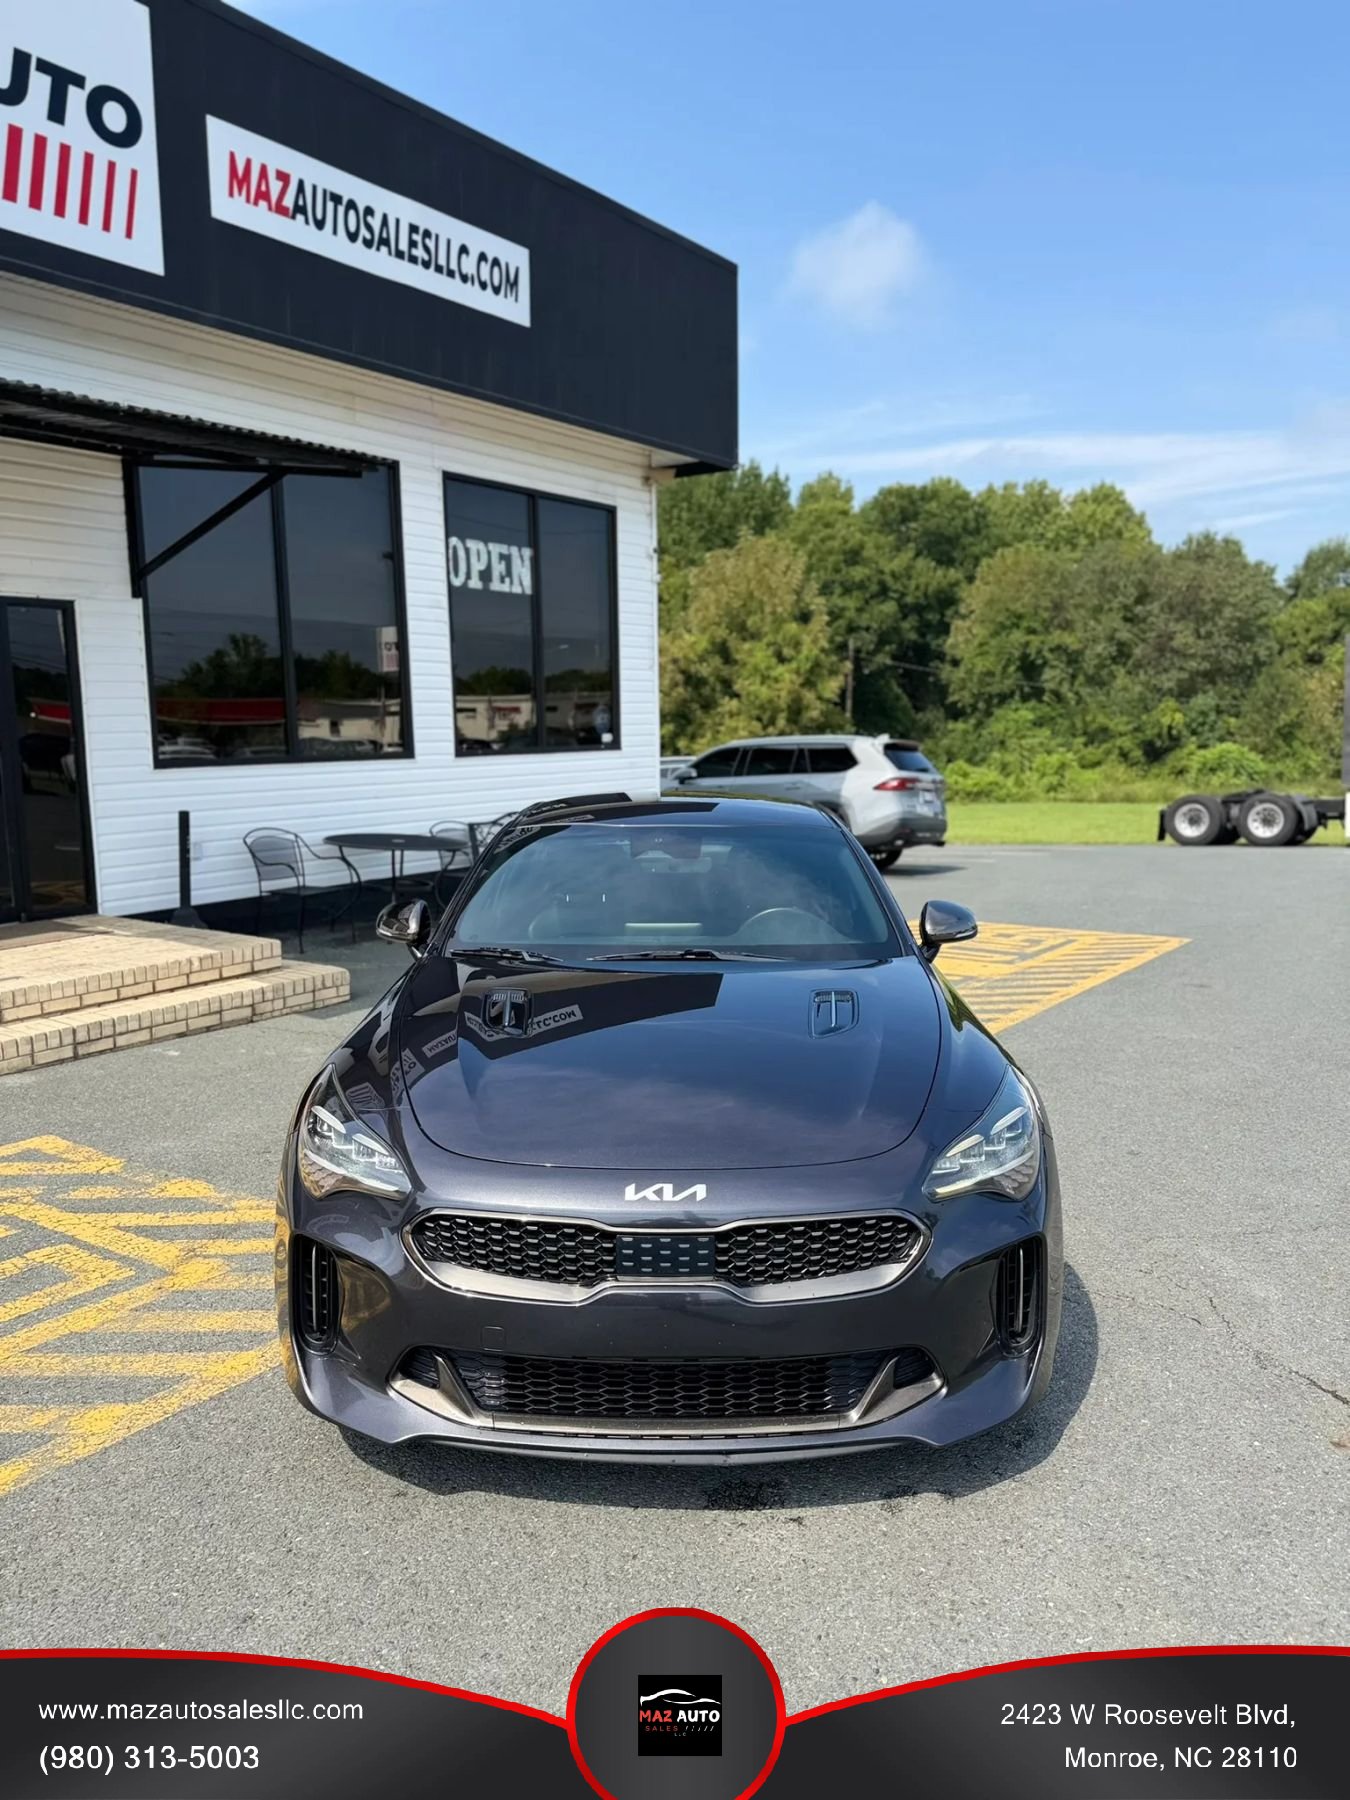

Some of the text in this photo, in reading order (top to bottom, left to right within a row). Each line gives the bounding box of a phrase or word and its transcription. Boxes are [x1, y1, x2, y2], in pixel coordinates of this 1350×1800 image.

[228, 151, 520, 303] MAZAUTOSALESLLC.COM
[448, 536, 534, 595] OPEN
[624, 1183, 707, 1202] KIA
